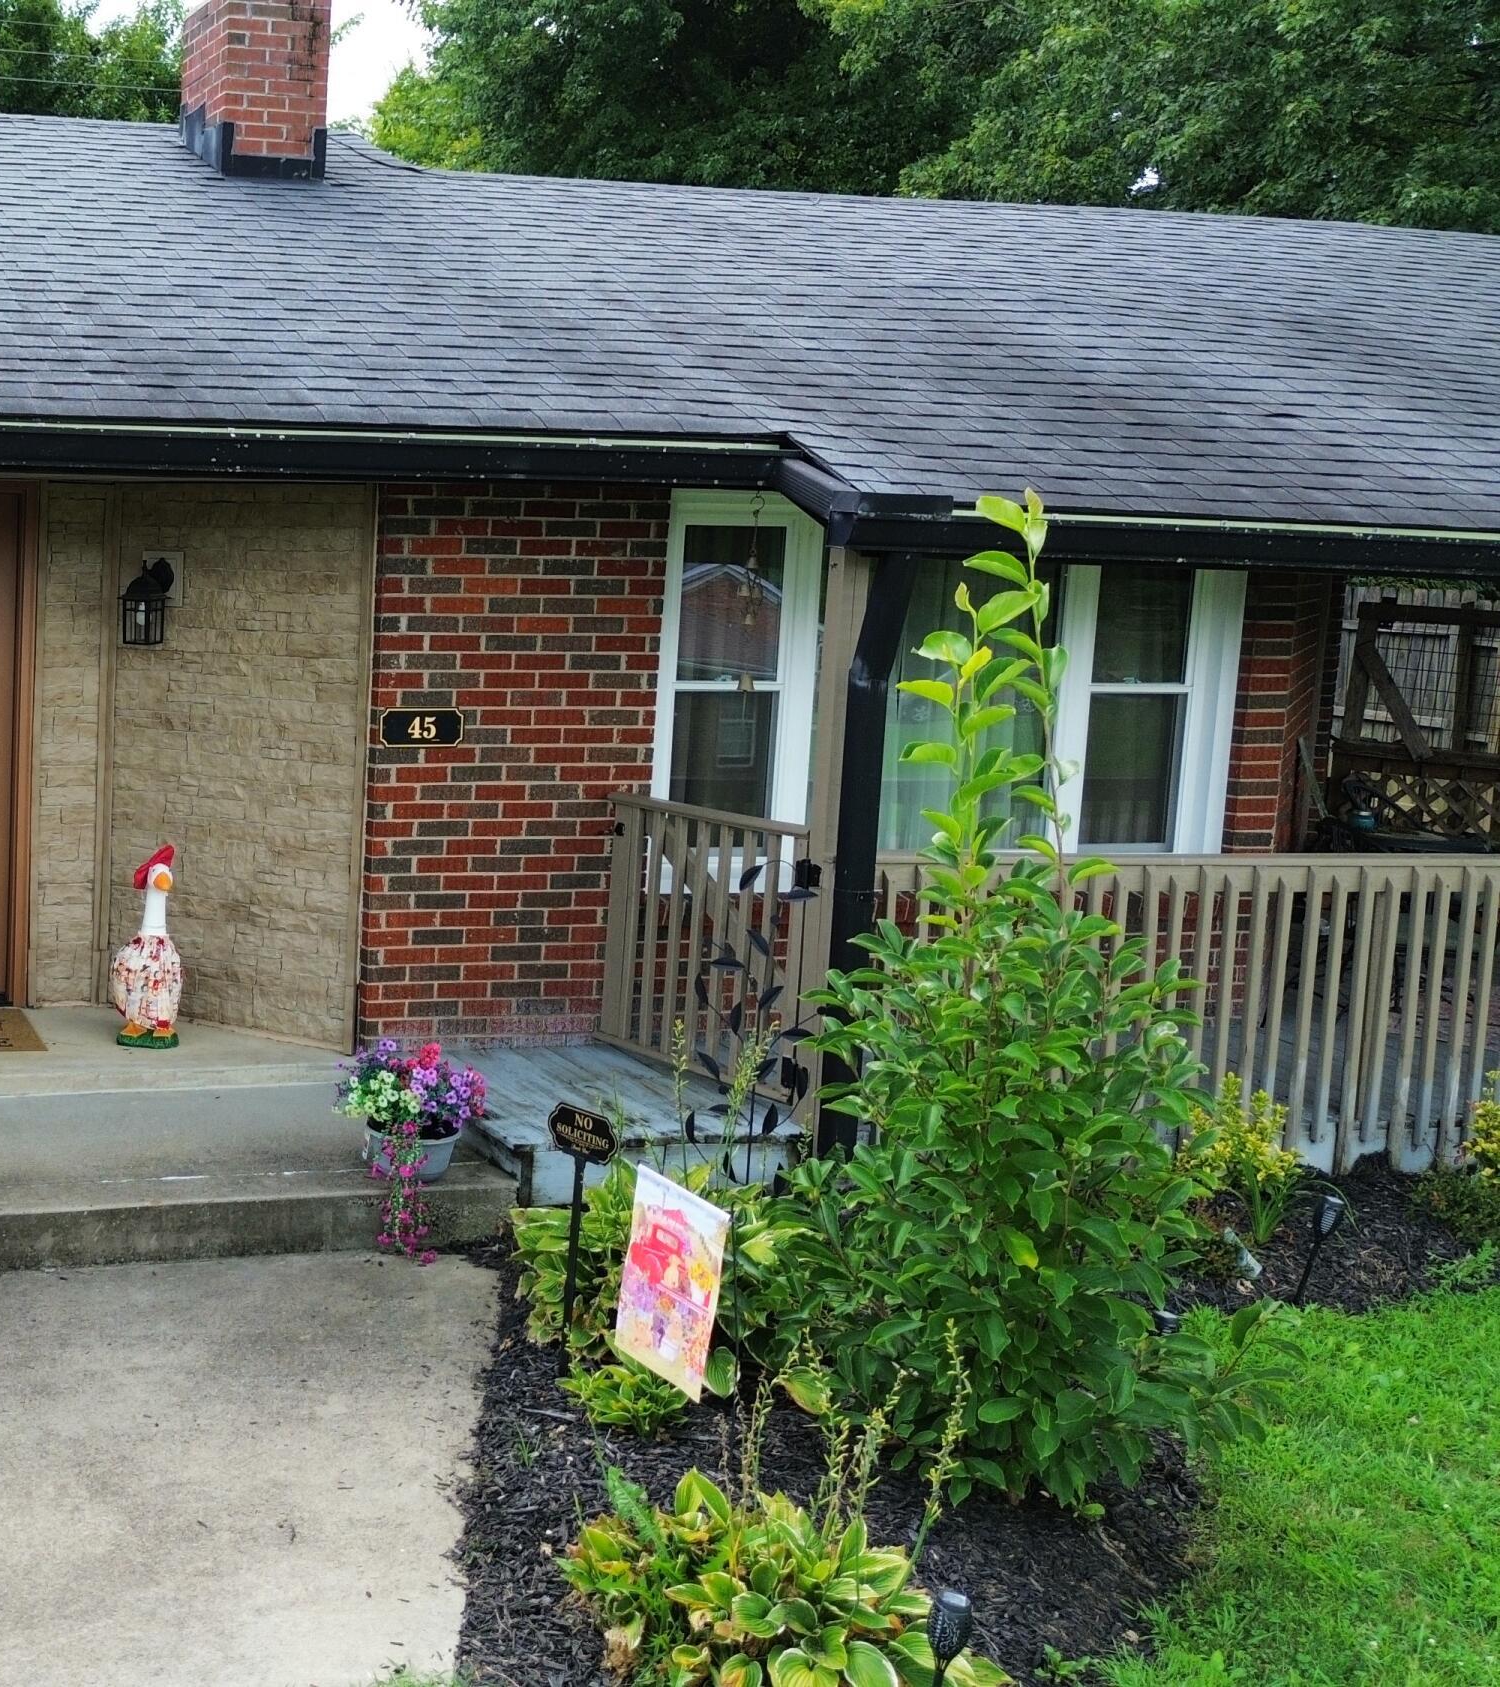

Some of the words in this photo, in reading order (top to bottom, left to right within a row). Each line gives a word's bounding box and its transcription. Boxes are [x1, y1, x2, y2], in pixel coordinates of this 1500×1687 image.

[407, 716, 437, 739] 45
[574, 1113, 593, 1130] NO
[556, 1122, 609, 1149] SOLICITING
